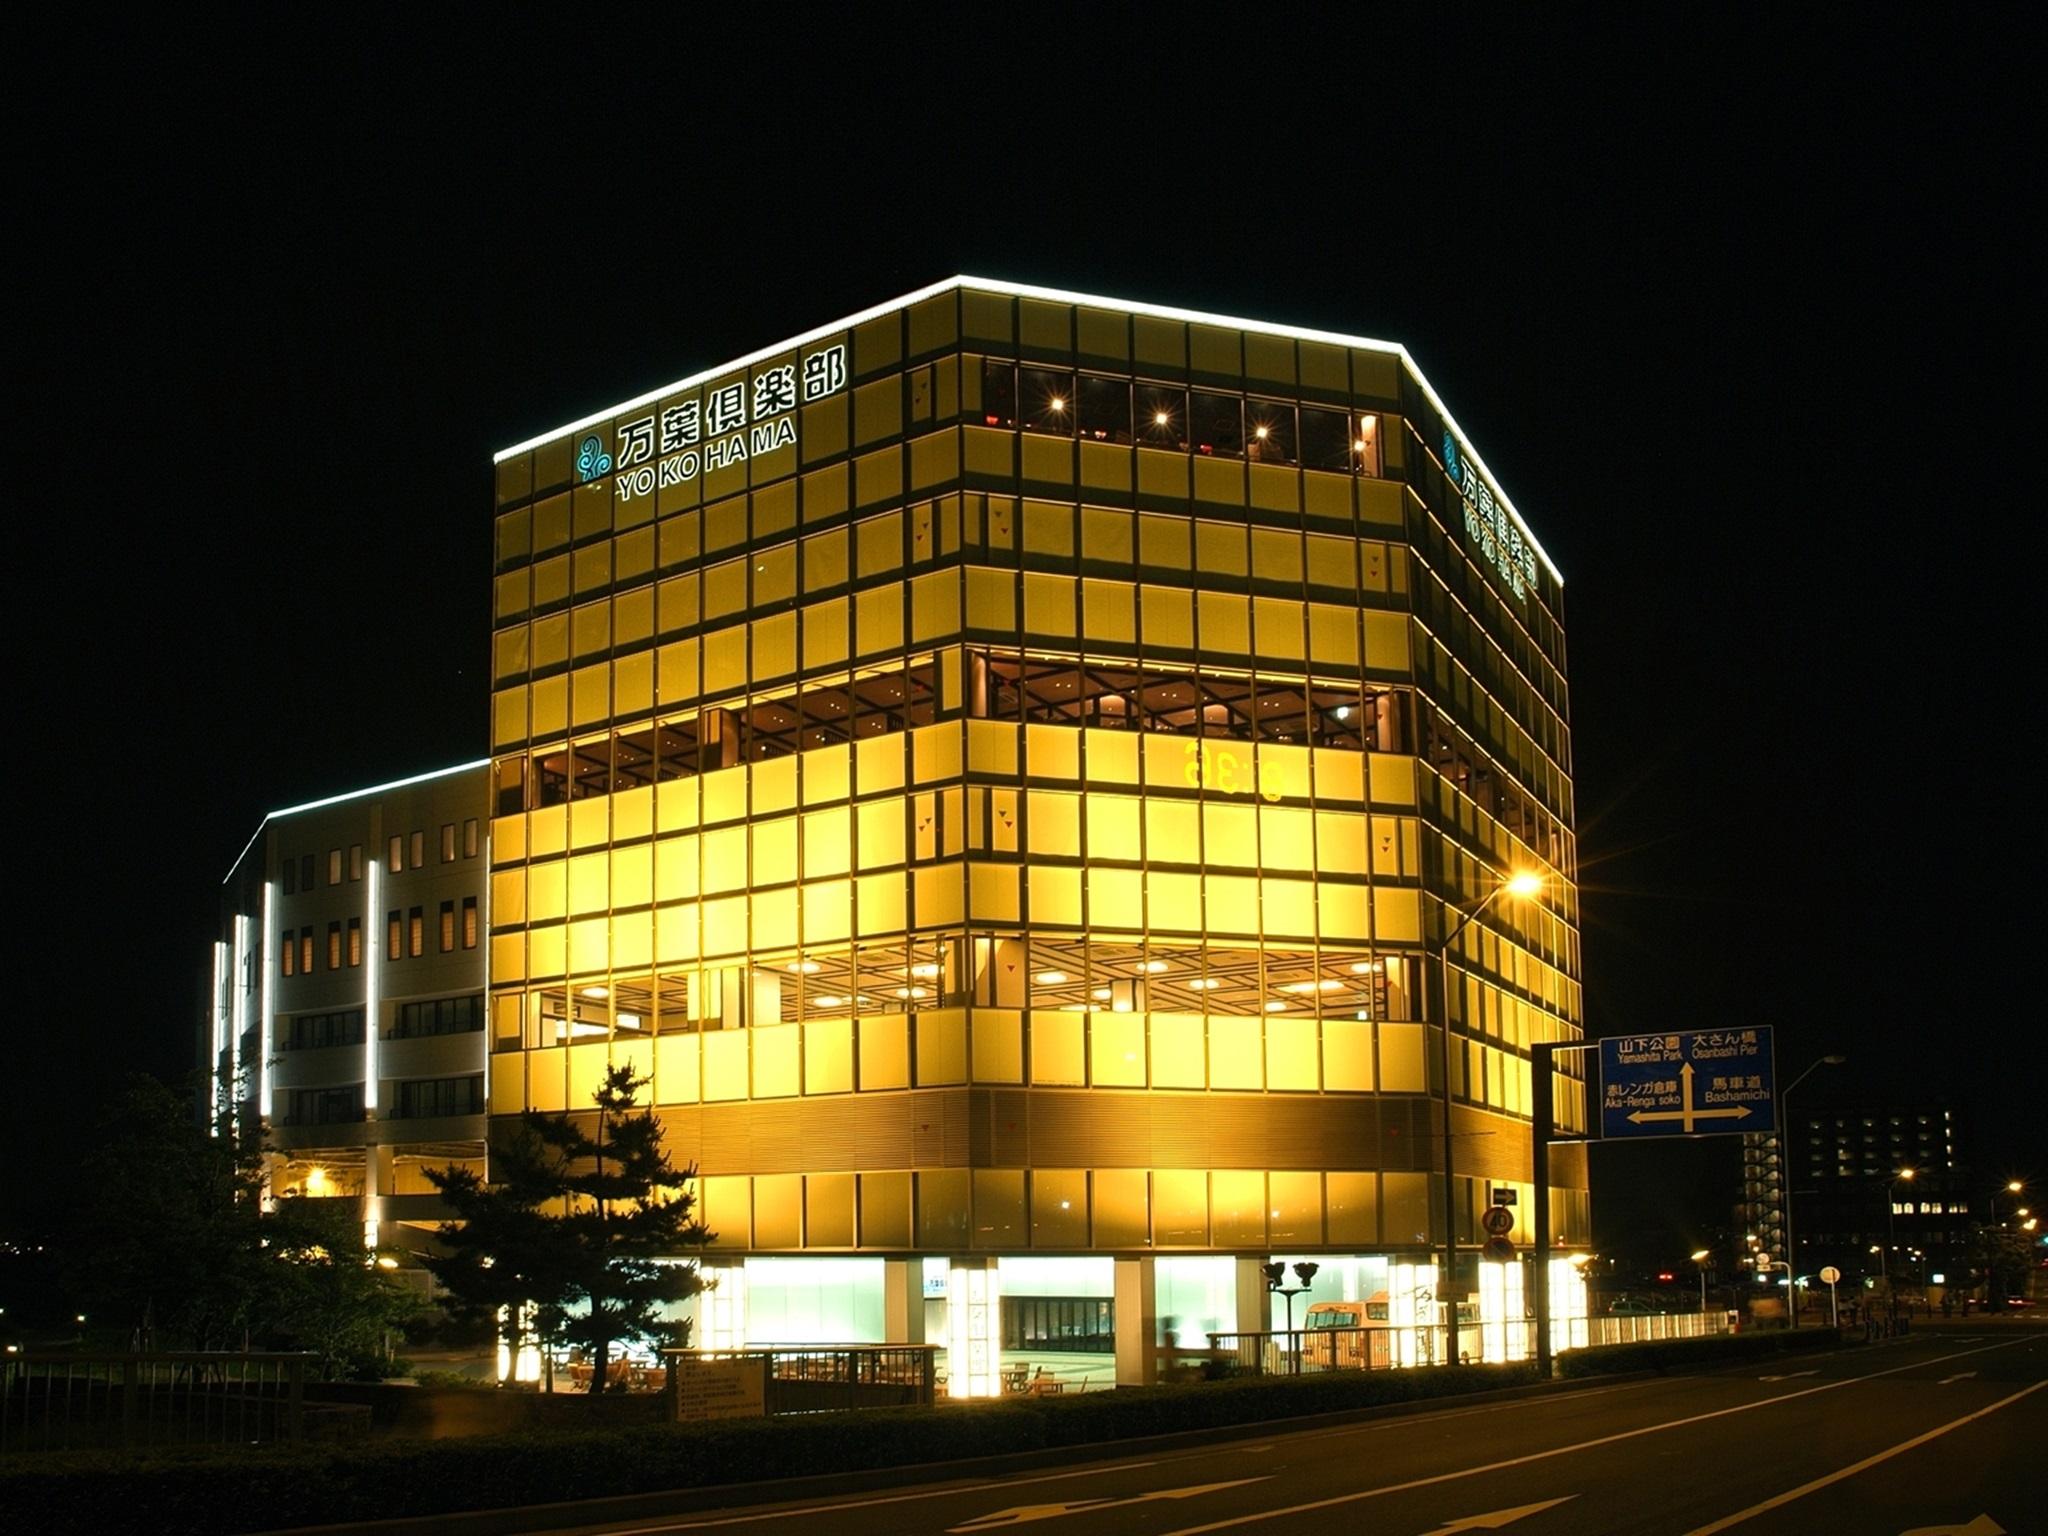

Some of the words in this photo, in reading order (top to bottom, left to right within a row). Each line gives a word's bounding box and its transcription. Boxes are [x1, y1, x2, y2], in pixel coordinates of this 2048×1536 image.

[617, 344, 847, 469] 万葉倶楽部
[616, 417, 797, 501] YOKOHAMA
[1619, 1036, 1680, 1053] 山下公園
[1617, 1051, 1661, 1064] Yamashita
[1663, 1049, 1683, 1061] Park
[1704, 1087, 1770, 1103] Bashamichi
[1490, 1212, 1508, 1229] 40
